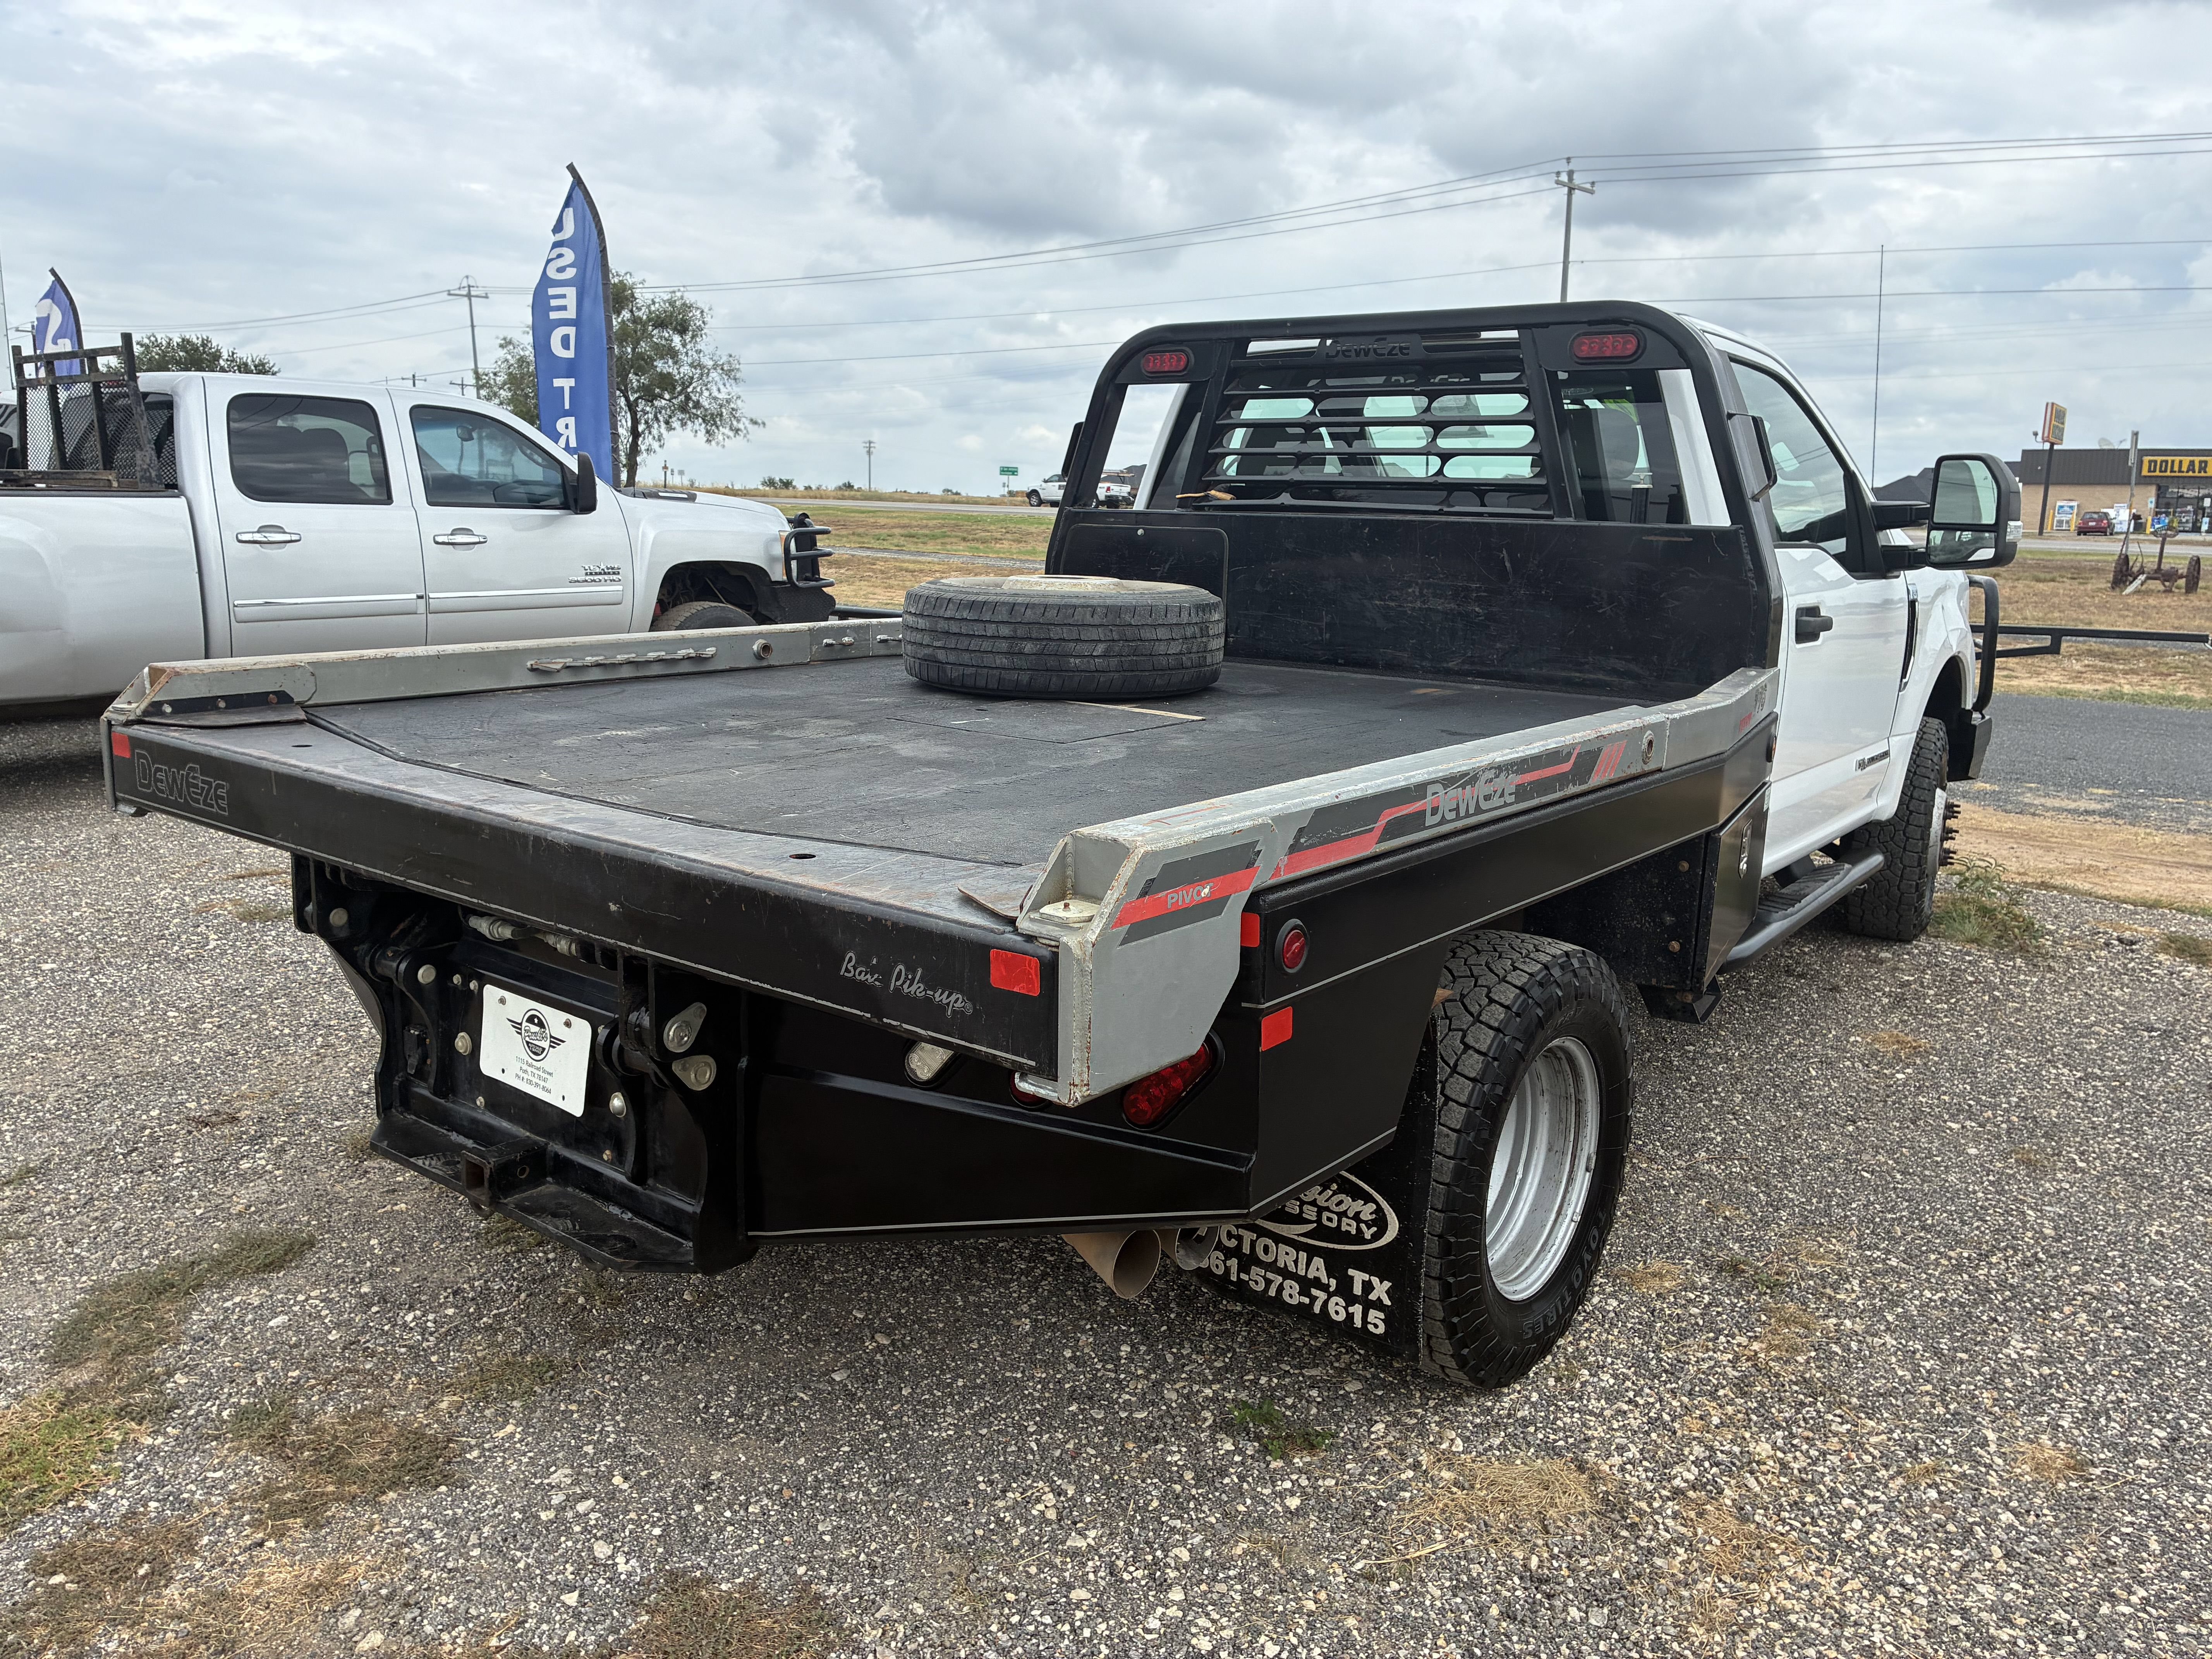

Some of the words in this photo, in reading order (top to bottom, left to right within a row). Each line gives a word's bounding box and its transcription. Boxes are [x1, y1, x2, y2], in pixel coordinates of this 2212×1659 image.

[2148, 459, 2208, 473] DOLLAR
[1167, 882, 1214, 909] PIVOT
[516, 1056, 525, 1065] 1115
[526, 1060, 541, 1072] Railroad
[542, 1067, 553, 1078] Street
[536, 1073, 548, 1084] 78147
[1278, 1200, 1377, 1240] SSORY
[1220, 1224, 1337, 1292] CTORIA,
[1347, 1268, 1392, 1306] TX
[1571, 1208, 1607, 1290] TOYO
[1523, 1285, 1572, 1339] TIRES
